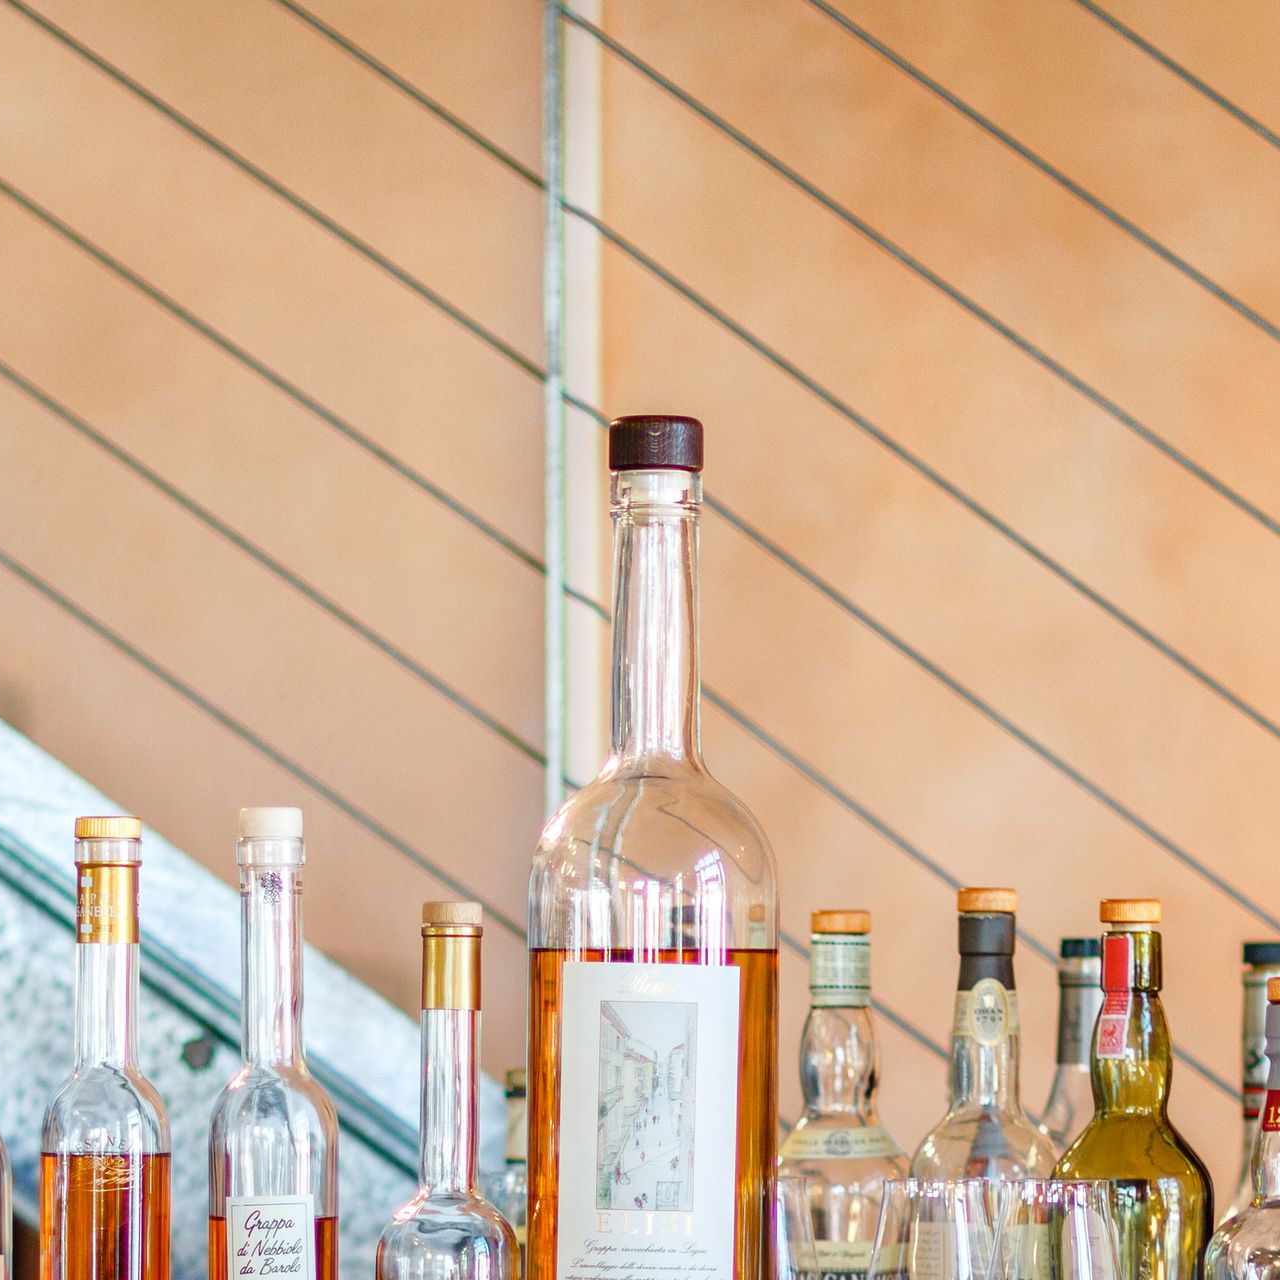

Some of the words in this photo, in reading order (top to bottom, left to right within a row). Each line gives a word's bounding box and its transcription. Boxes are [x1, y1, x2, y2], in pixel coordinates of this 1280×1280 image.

[244, 1209, 295, 1239] Grappa
[237, 1241, 250, 1257] di
[251, 1238, 303, 1257] Nebbiolo
[583, 1239, 617, 1255] Grappa
[240, 1259, 255, 1275] da
[260, 1257, 301, 1276] Barolo
